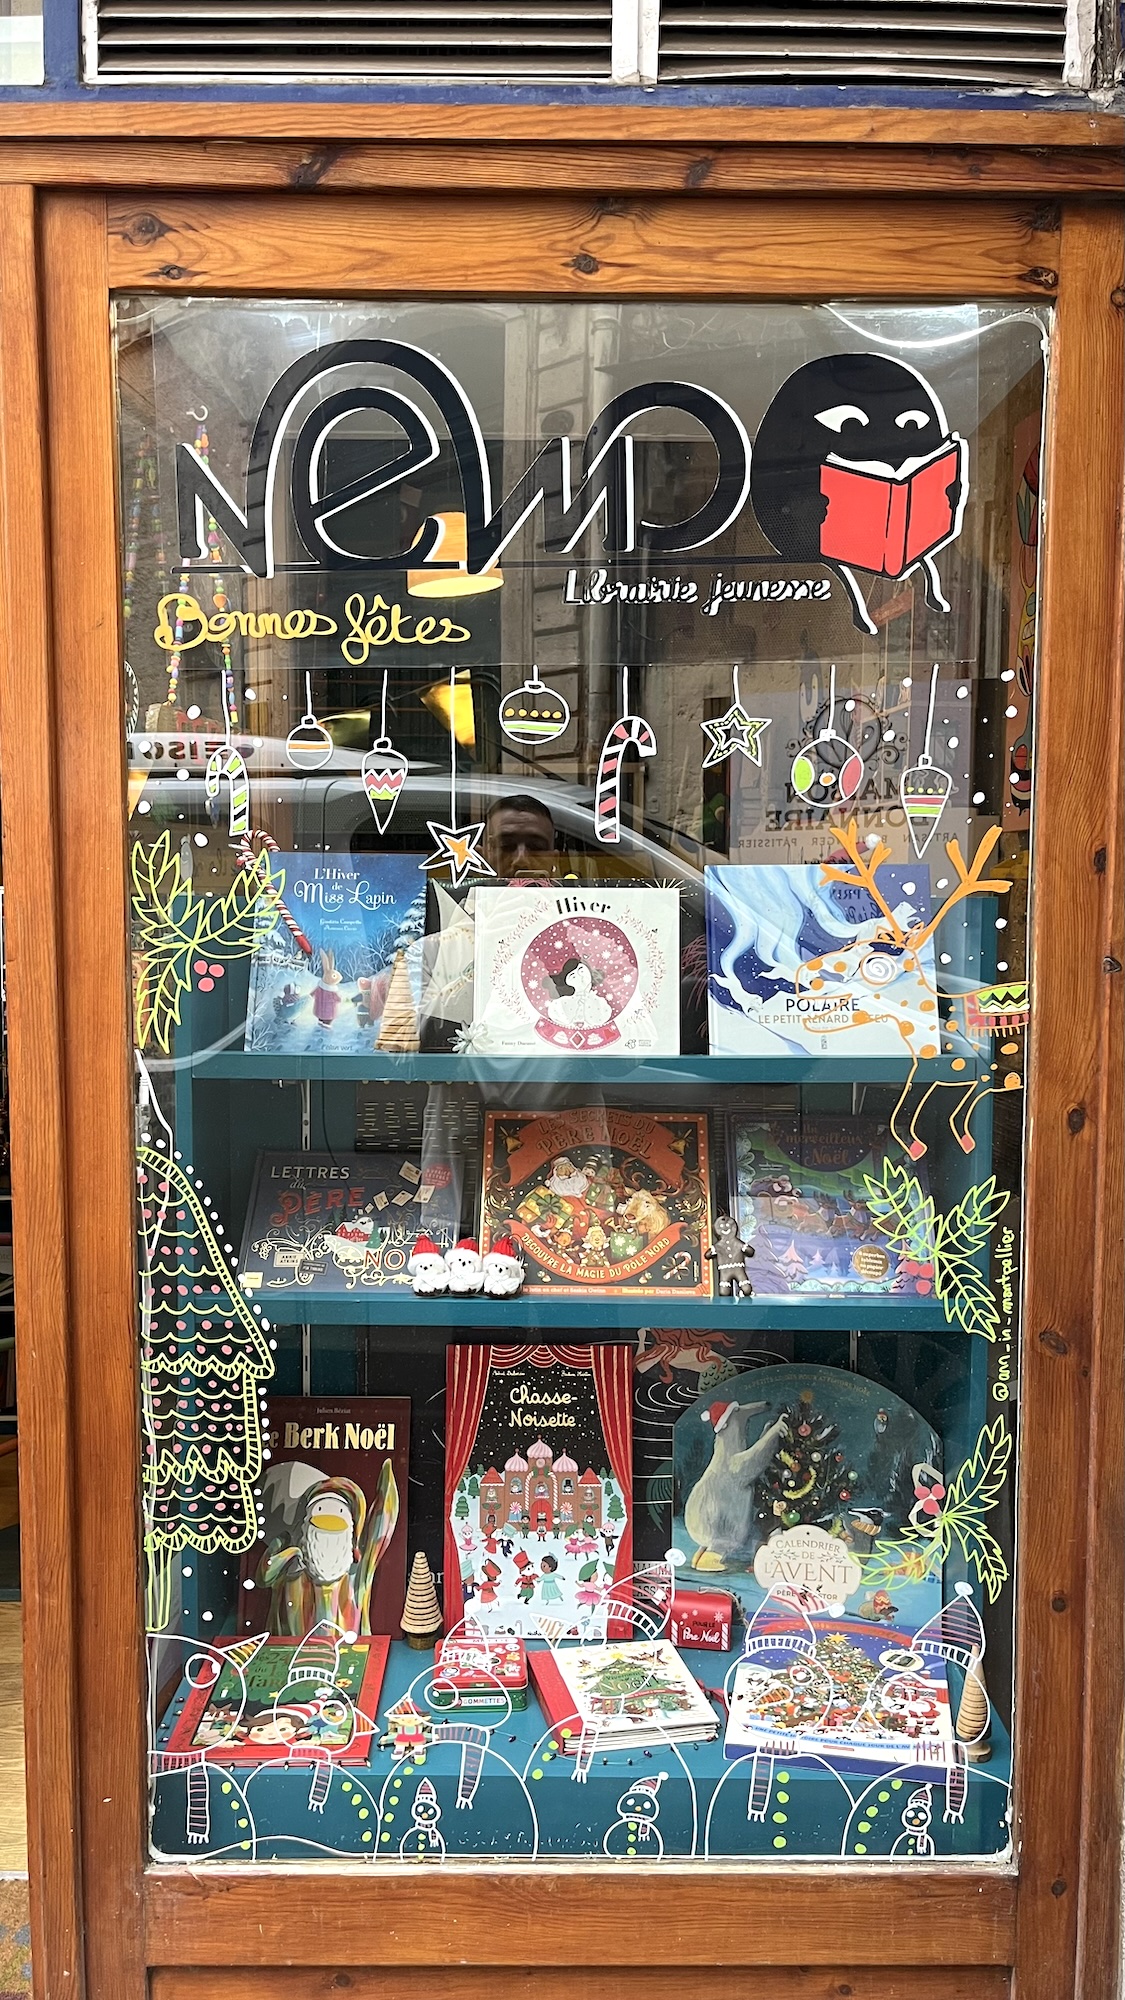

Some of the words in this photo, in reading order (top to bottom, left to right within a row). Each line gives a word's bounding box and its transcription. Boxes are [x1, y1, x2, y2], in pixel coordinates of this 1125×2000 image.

[563, 568, 699, 605] Librairie
[700, 572, 832, 616] jeunesse
[154, 593, 338, 650] Bonnes
[341, 594, 471, 666] fêtes
[314, 868, 360, 880] L'Hiver
[293, 880, 344, 913] Miss
[346, 880, 397, 911] Lapin
[331, 883, 343, 891] de
[556, 896, 611, 914] Hiver
[758, 1014, 770, 1024] LE
[772, 1014, 801, 1024] PETIT
[537, 1122, 595, 1157] PÈRE
[602, 1125, 655, 1160] NOËL
[270, 1166, 350, 1179] LETTRES
[269, 1186, 366, 1227] PÈRE
[521, 1232, 561, 1269] DÉCOUVRE
[560, 1263, 573, 1275] LA
[575, 1267, 606, 1279] MAGIE
[609, 1267, 623, 1278] DU
[623, 1255, 648, 1273] PÔLE
[645, 1237, 671, 1258] NORD
[509, 1384, 578, 1404] Chasse-
[508, 1407, 577, 1427] Noisette
[283, 1422, 340, 1450] Berk
[344, 1423, 396, 1450] Noël
[776, 1540, 840, 1553] CALENDRIER
[802, 1551, 815, 1560] DE
[764, 1560, 853, 1584] L'AVENT
